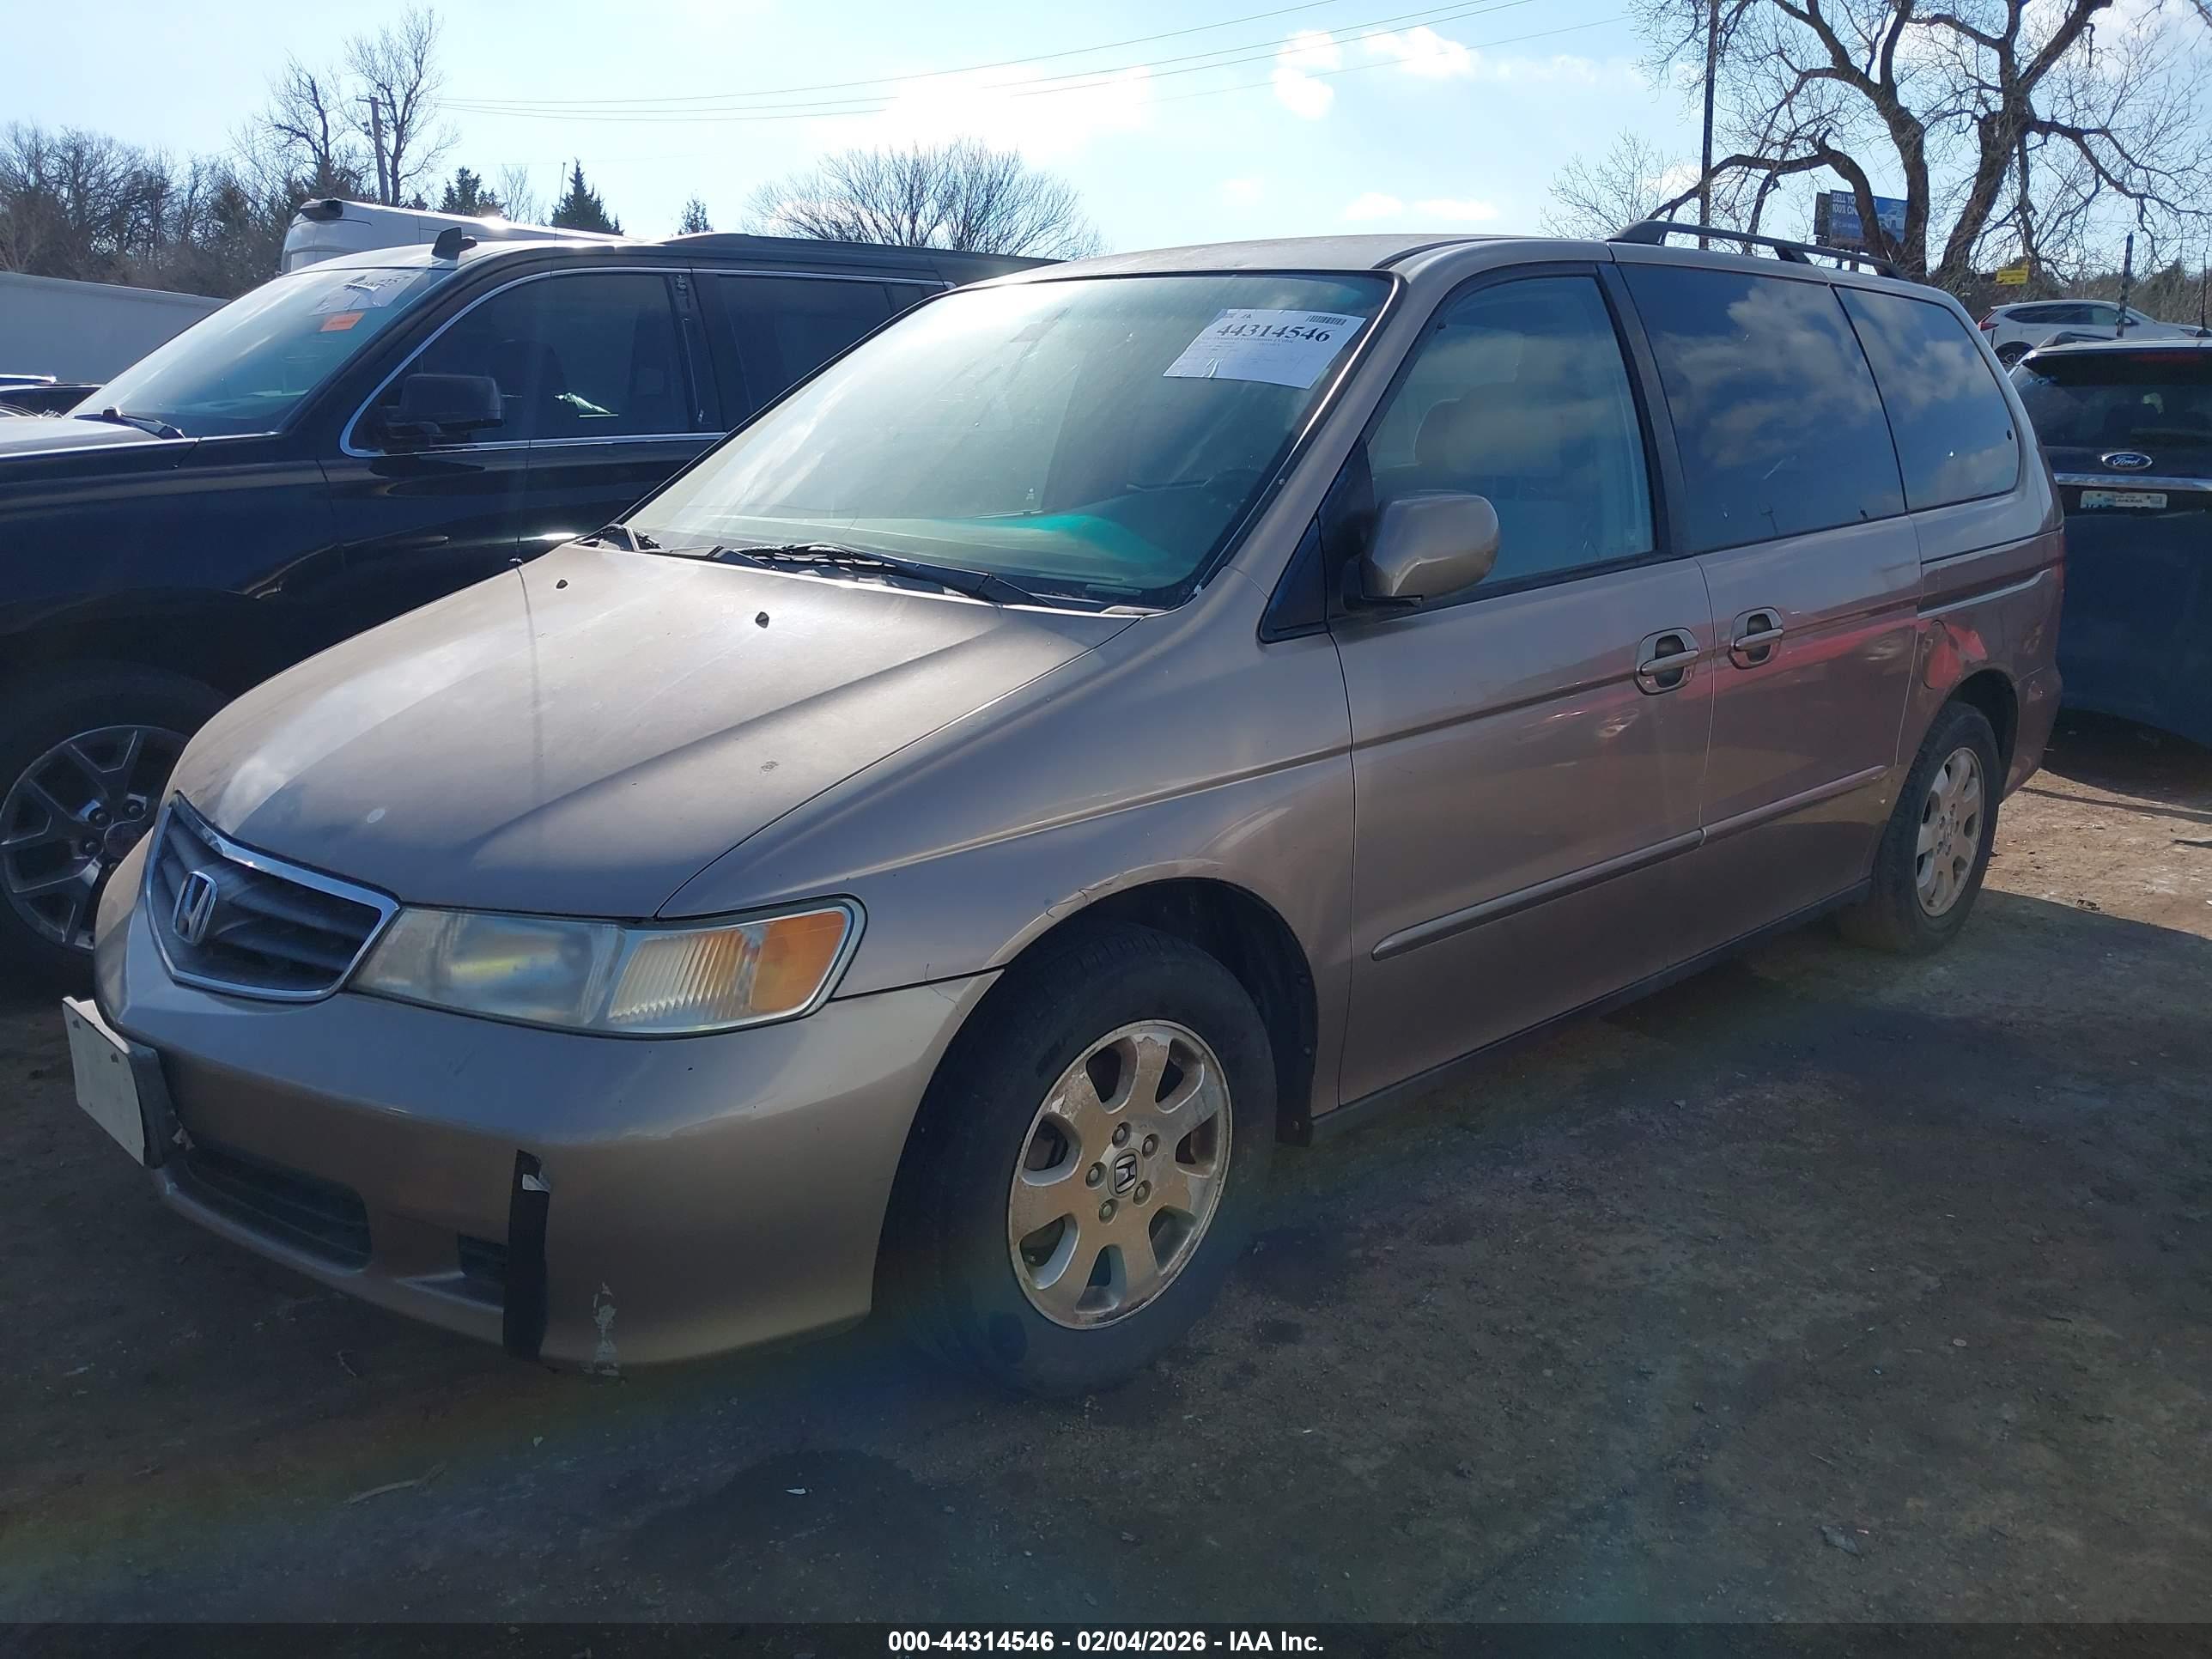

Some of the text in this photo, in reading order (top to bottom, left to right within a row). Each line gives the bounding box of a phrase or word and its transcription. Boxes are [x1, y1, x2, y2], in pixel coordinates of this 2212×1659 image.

[1832, 192, 1856, 204] SELL YO
[1217, 324, 1336, 342] 44314546
[2113, 455, 2141, 466] Ford
